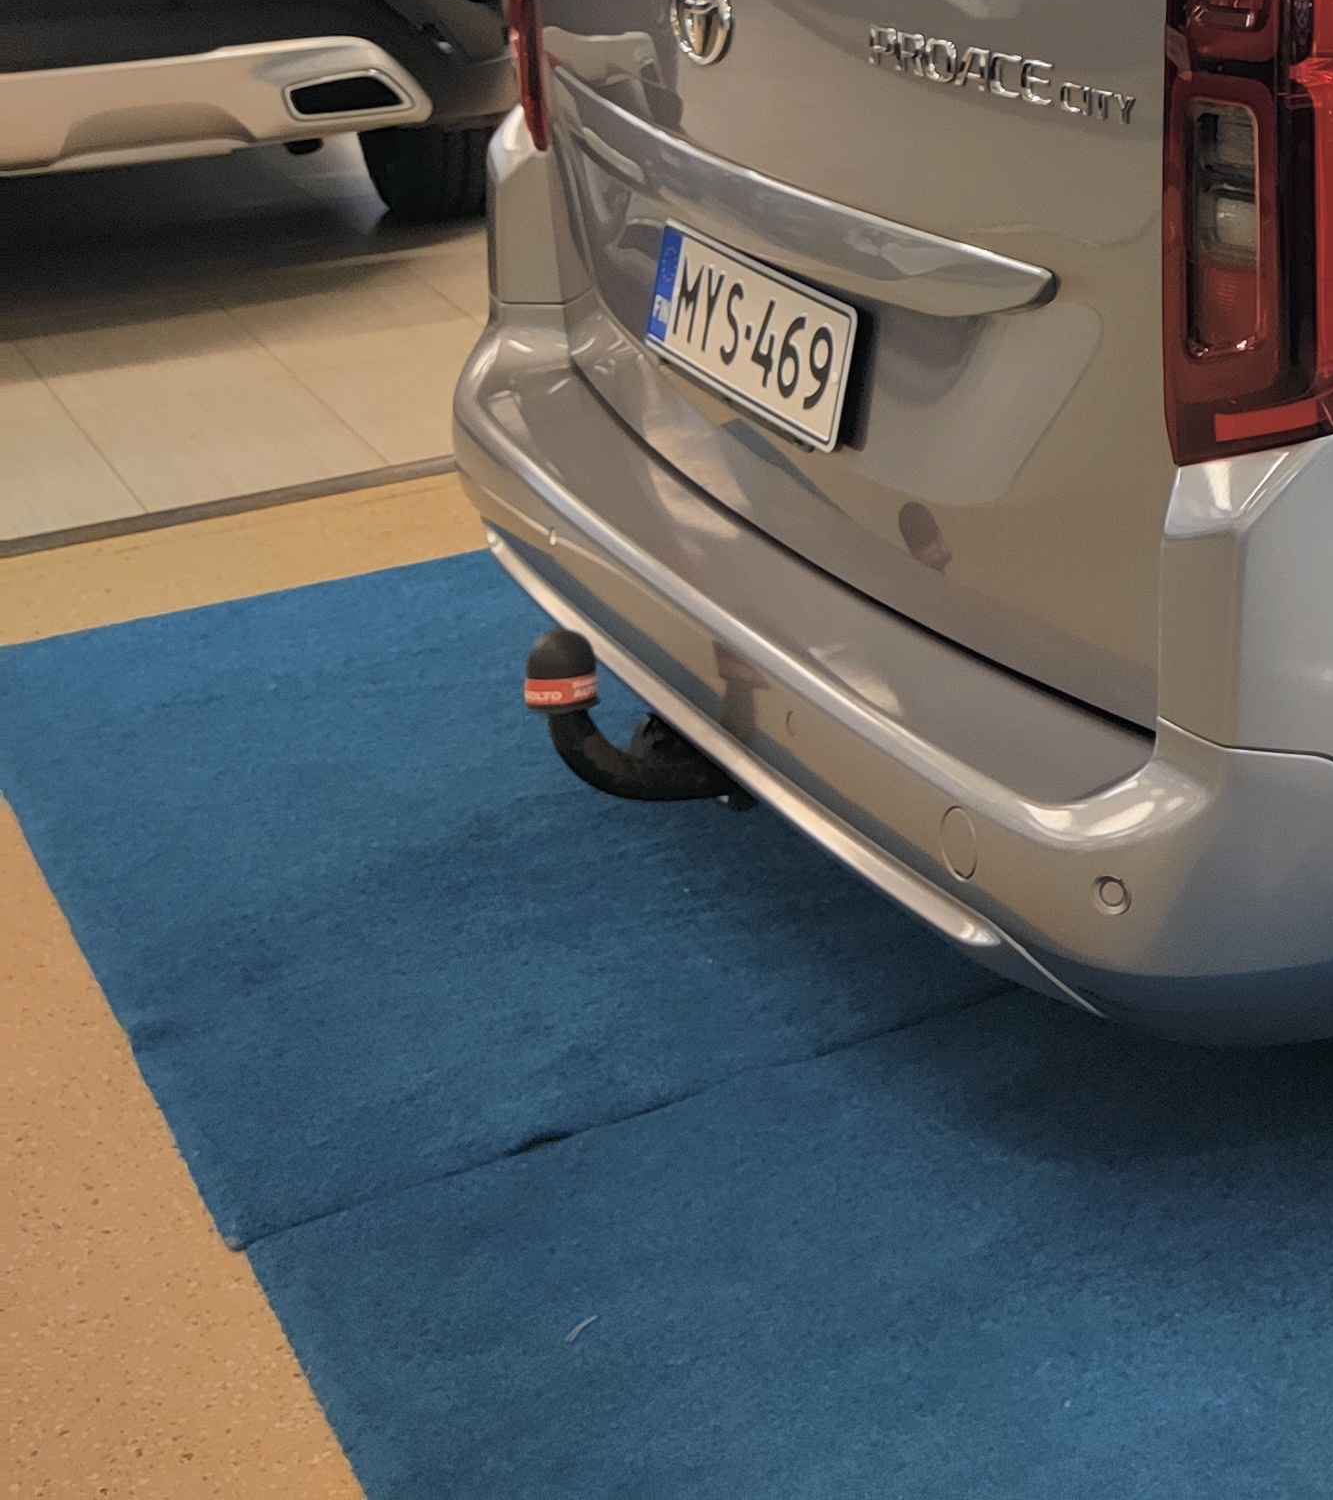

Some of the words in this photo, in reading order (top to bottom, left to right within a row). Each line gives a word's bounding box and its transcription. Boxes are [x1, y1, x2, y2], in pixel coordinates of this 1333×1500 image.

[869, 25, 1053, 105] PROACE
[1060, 82, 1136, 125] CITY
[672, 257, 833, 410] MYS-469
